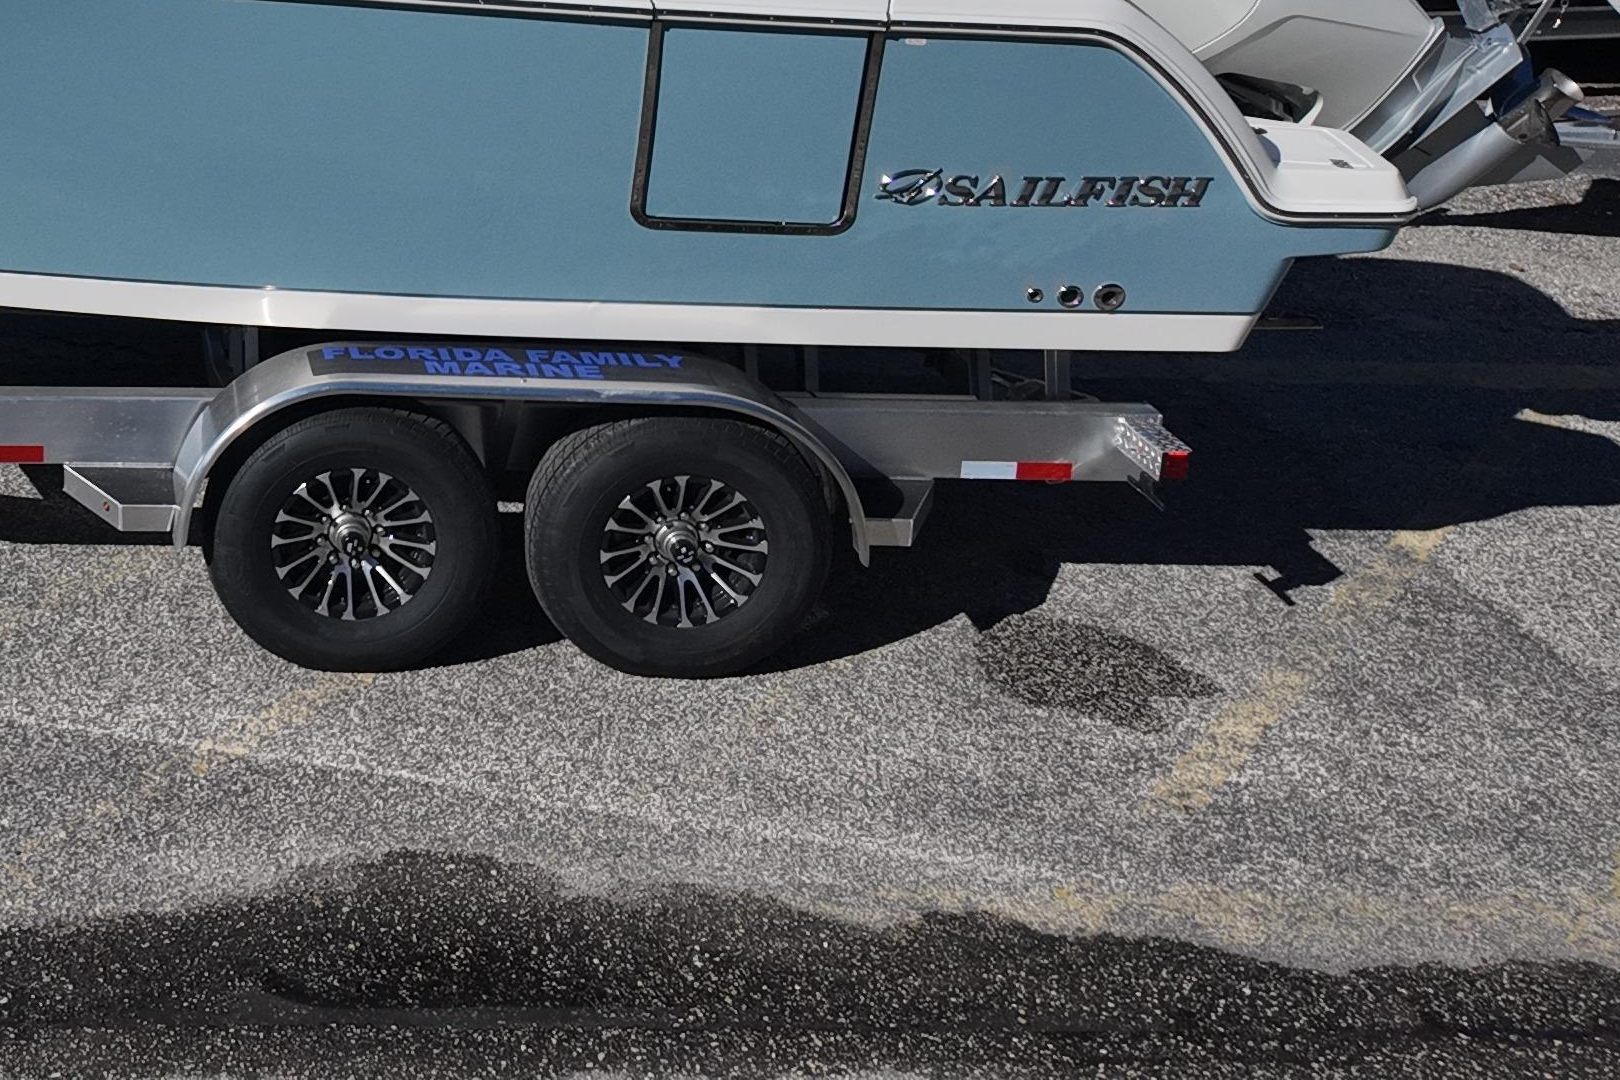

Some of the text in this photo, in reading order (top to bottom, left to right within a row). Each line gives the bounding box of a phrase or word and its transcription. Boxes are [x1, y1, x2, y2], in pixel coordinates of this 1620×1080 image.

[939, 174, 1214, 206] SAILFISH
[321, 347, 684, 368] FLORIDA FAMILY
[424, 361, 604, 379] MARINE
